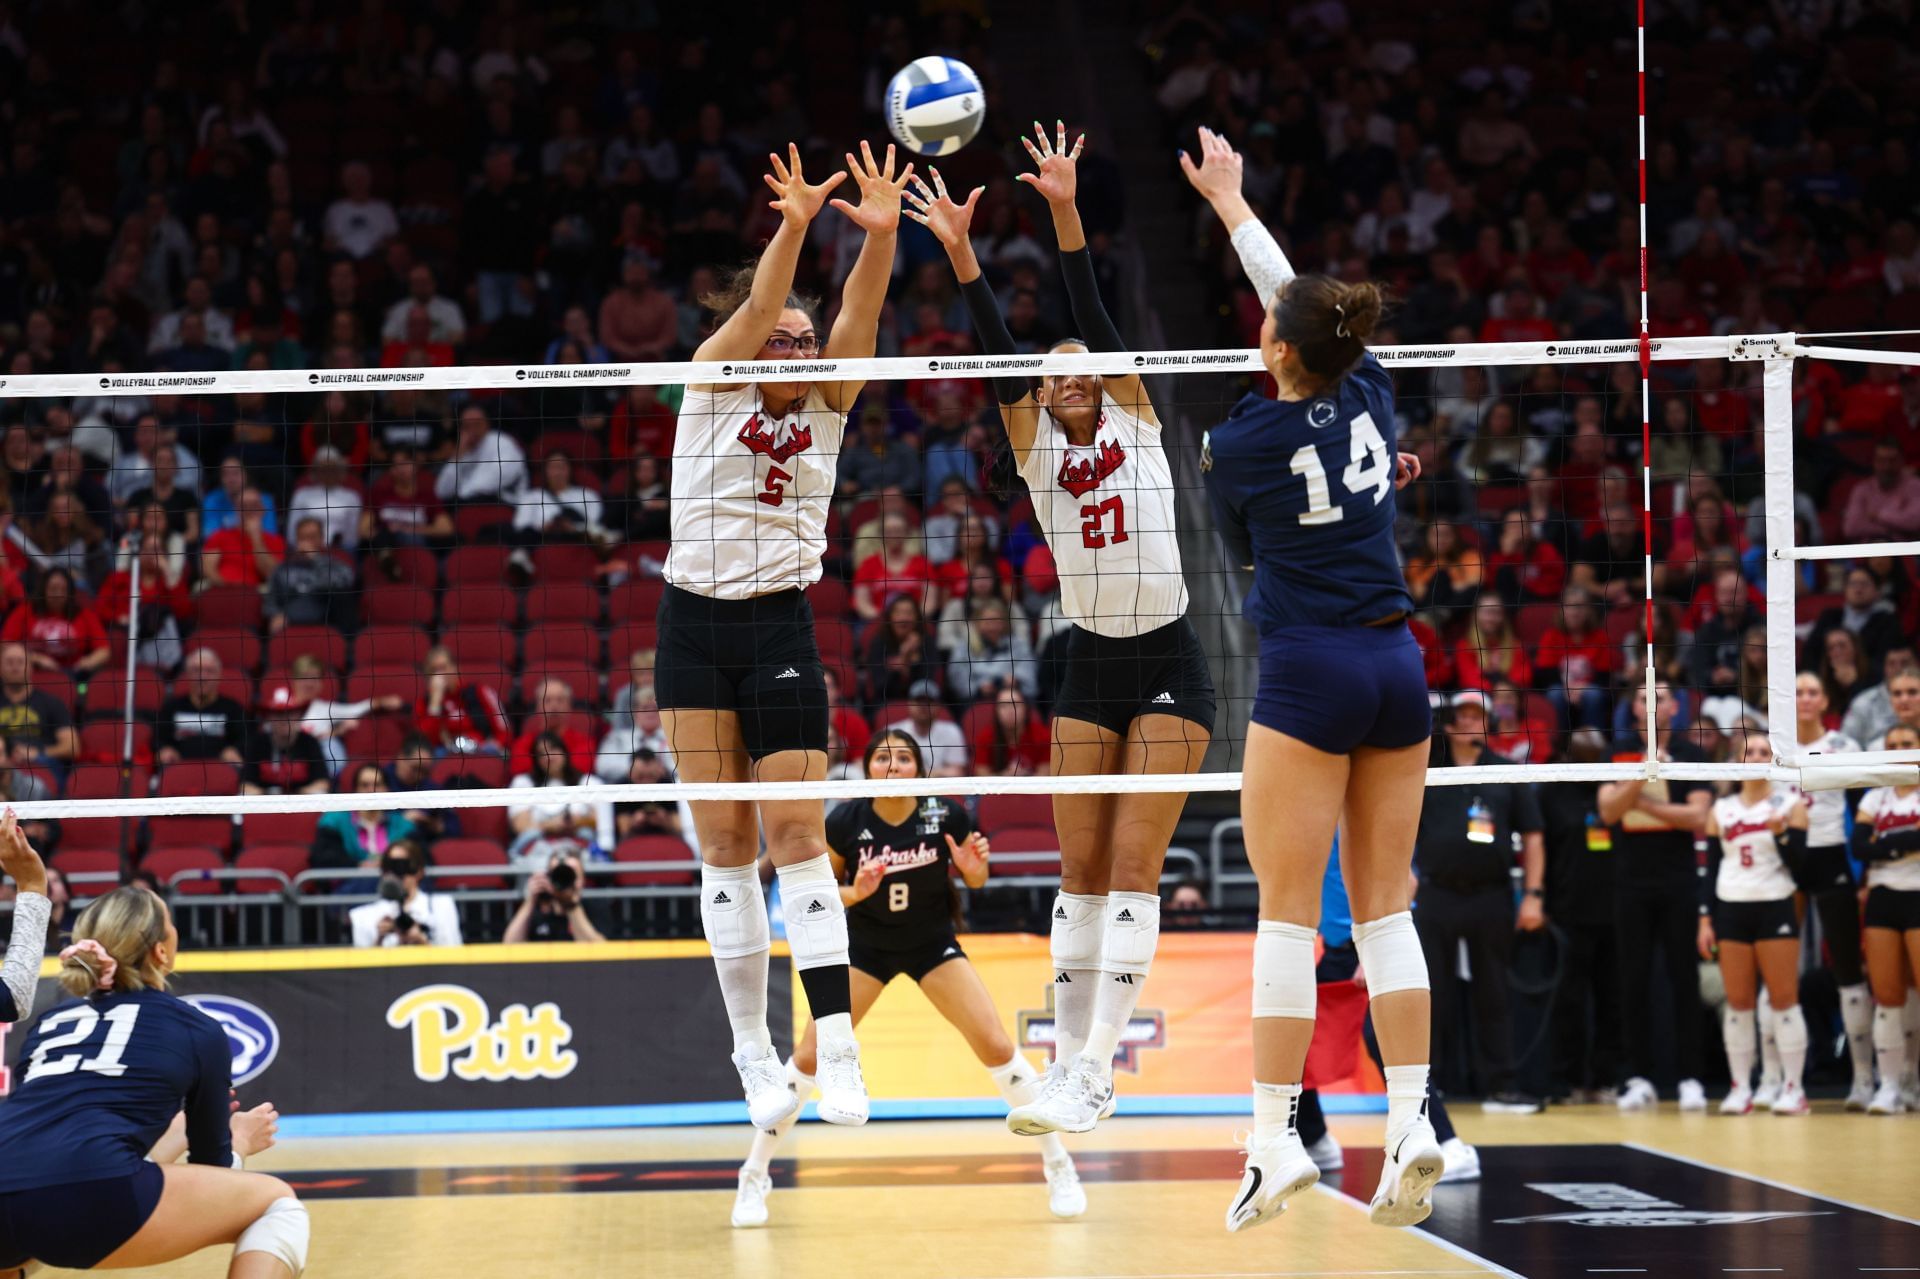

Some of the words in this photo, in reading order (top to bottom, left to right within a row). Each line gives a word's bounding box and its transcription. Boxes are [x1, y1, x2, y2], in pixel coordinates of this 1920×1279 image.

[1749, 337, 1777, 346] Senoh
[1374, 351, 1396, 360] YBALL
[1397, 349, 1456, 359] CHAMPIONSHIP
[1558, 345, 1602, 355] VOLLEYBALL
[1603, 343, 1662, 354] CHAMPIOHIP
[940, 361, 984, 370] VOLLEYBALL
[985, 359, 1043, 368] CHAMPIONSHIP
[1146, 356, 1190, 365] VOLLEYBALL
[1191, 354, 1249, 364] CHAMPIONSHIP
[527, 370, 571, 379] VOLLEYBALL
[572, 369, 631, 378] CHAMPIONSHIP
[734, 365, 778, 374] VOLLEYBALL
[779, 364, 837, 373] CHAMPIONSHIP
[111, 378, 156, 387] VOLLEYBALL
[157, 377, 217, 386] CHAMPIONSHIP
[320, 374, 364, 383] VOLLEYBALL
[366, 373, 425, 382] CHAMPIONSHIP
[1289, 410, 1392, 525] 14
[758, 465, 793, 507] 5
[1080, 494, 1129, 549] 27
[889, 882, 909, 912] 8
[806, 906, 826, 914] adidas
[1115, 915, 1135, 923] adidas
[386, 983, 578, 1082] Pitt
[23, 1003, 141, 1084] 21
